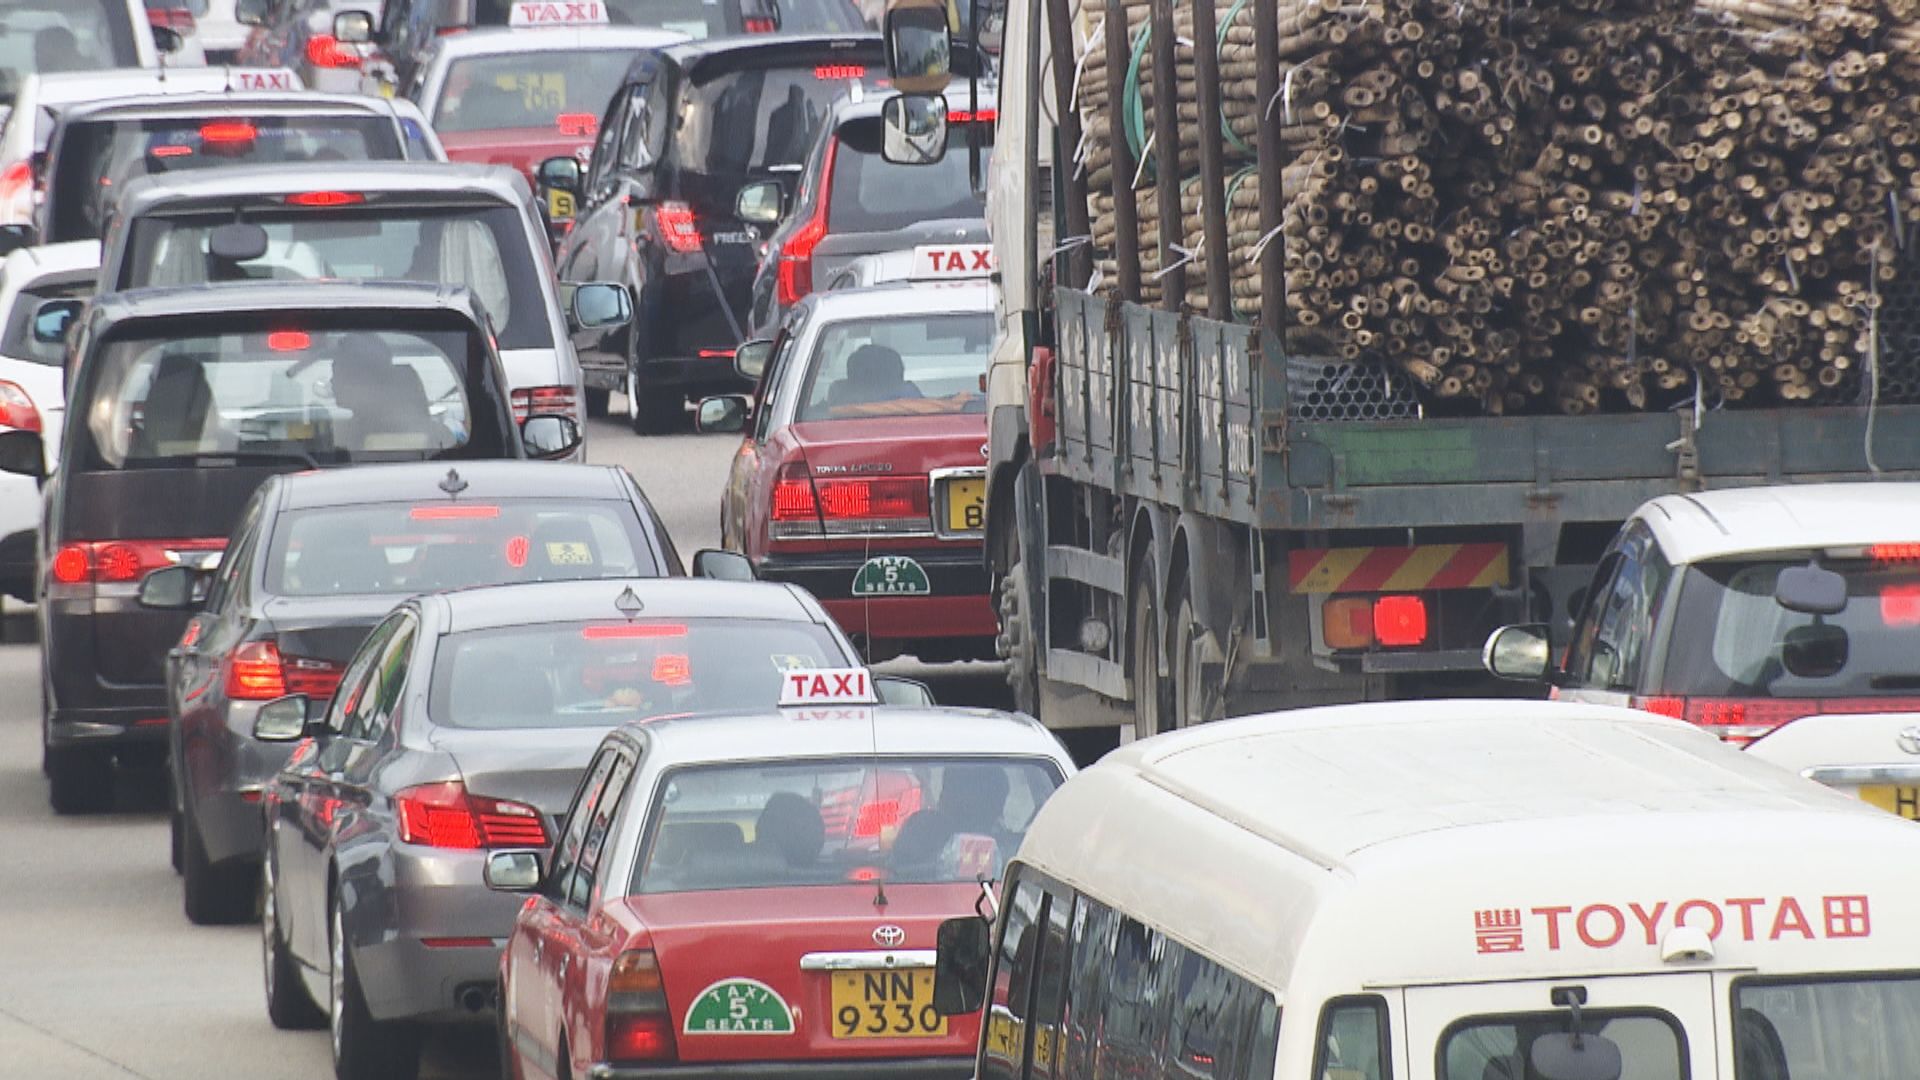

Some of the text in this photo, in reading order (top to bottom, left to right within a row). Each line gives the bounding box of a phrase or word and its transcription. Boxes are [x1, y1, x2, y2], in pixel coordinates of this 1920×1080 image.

[520, 3, 598, 22] TAXI
[240, 73, 290, 89] TAXI
[928, 250, 993, 272] TAX
[872, 557, 909, 570] TAXI
[885, 566, 898, 582] 5
[866, 582, 917, 592] SEATS
[790, 673, 864, 697] TAXI
[1531, 896, 1815, 951] TOYOTA
[1823, 895, 1871, 938] 田
[708, 985, 769, 1003] TAXI
[863, 971, 914, 1002] NN
[729, 997, 749, 1020] 5
[705, 1018, 774, 1031] SEATS
[838, 1003, 941, 1035] 9330
